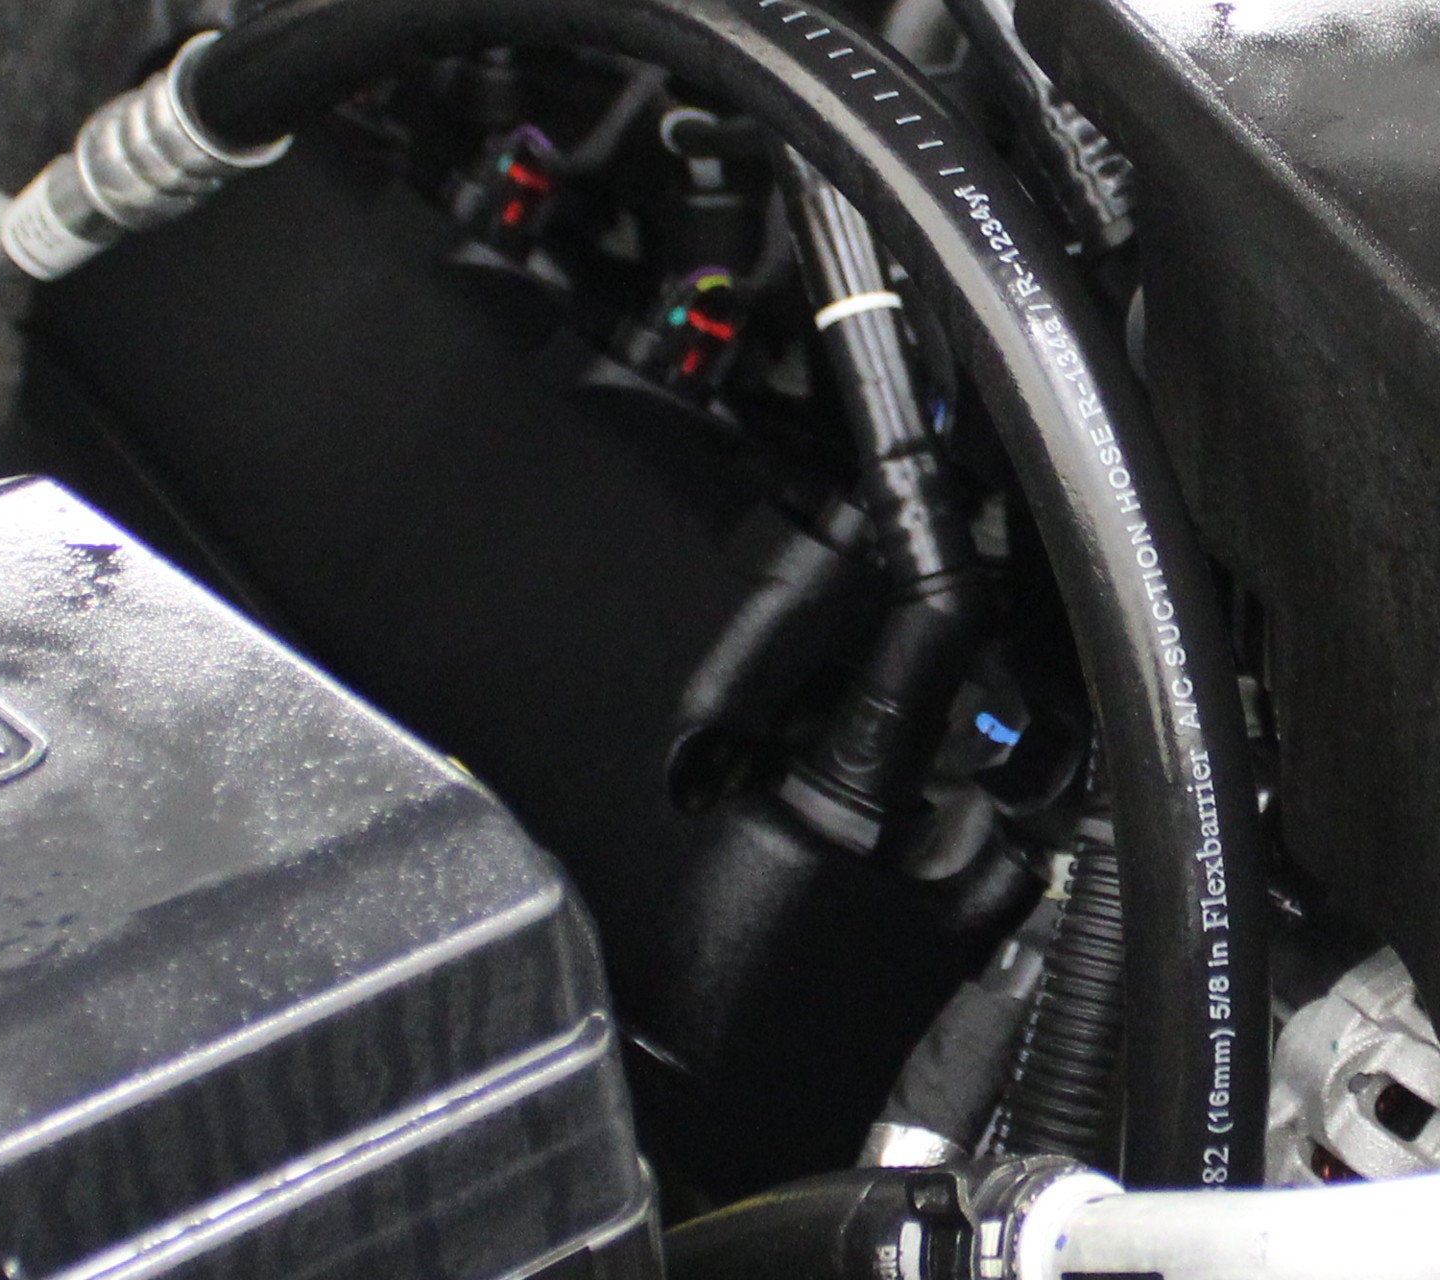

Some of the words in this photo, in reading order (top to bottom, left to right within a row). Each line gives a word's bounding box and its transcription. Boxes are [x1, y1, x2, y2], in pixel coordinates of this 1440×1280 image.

[952, 183, 1042, 299] R-1234yf
[1043, 314, 1104, 420] R-134a
[1089, 423, 1142, 514] HOSE
[1126, 520, 1188, 669] SUCTION
[1170, 676, 1202, 731] A/C
[1185, 750, 1230, 933] Flexbarrier
[1208, 940, 1229, 967] in
[1208, 974, 1232, 1020] 5/8
[1207, 1028, 1236, 1134] (16mm)
